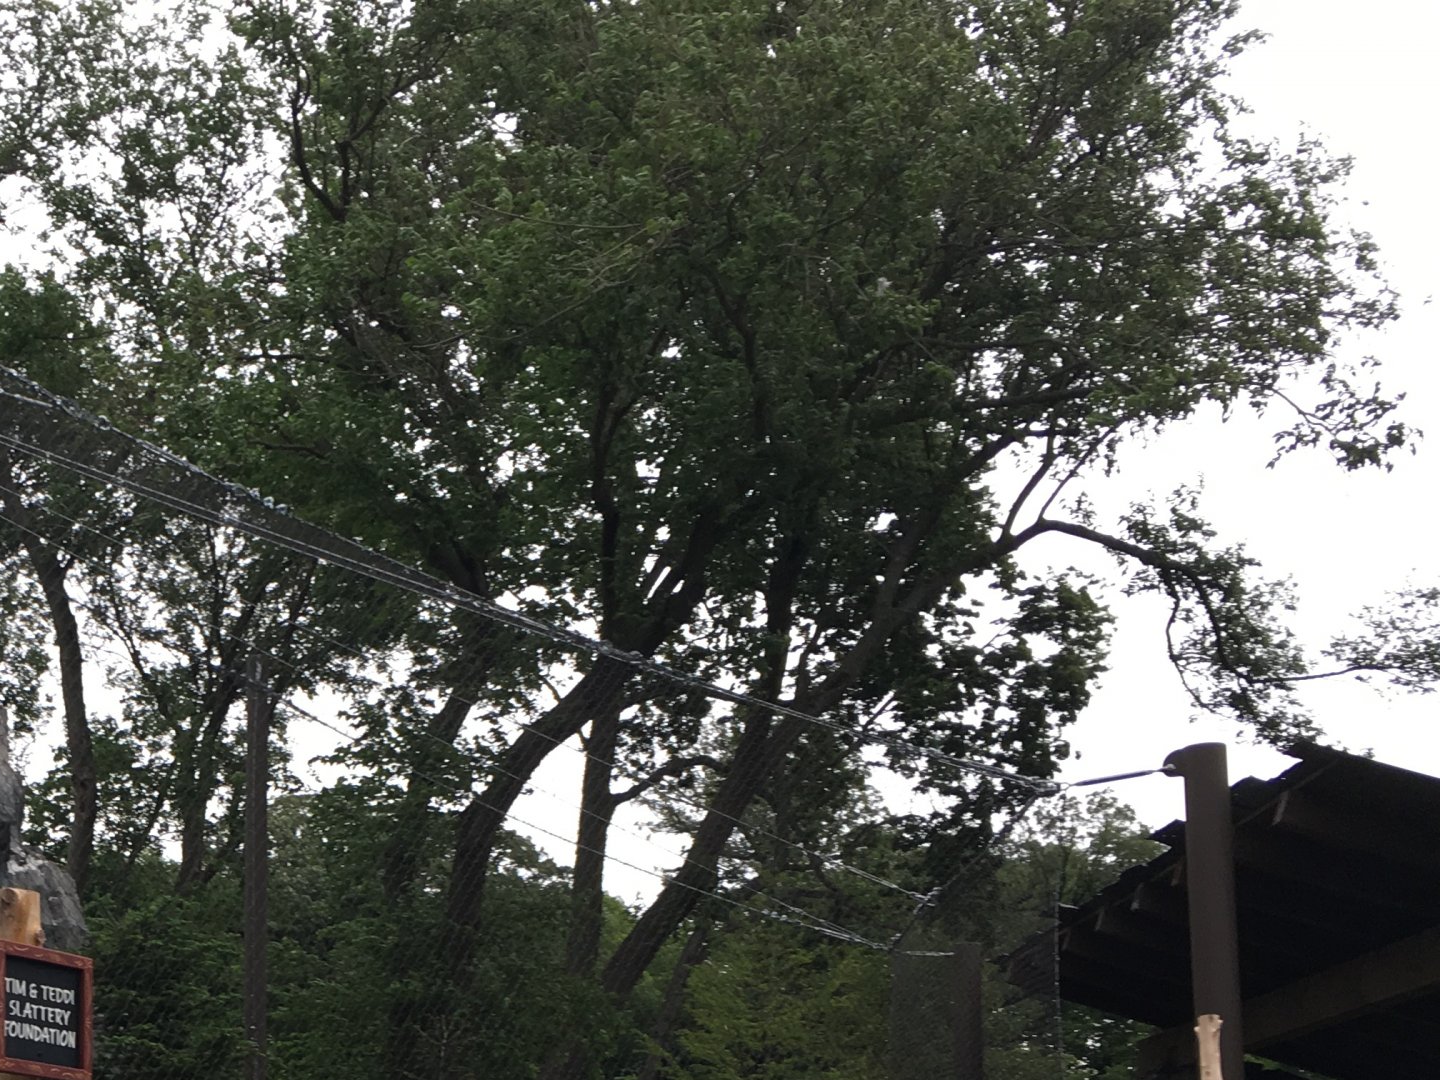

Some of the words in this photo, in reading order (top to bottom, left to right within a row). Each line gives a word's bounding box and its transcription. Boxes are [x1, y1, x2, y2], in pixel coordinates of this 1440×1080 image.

[4, 977, 27, 997] TIM
[29, 983, 39, 999] &
[40, 984, 76, 1006] TEDDI
[9, 999, 72, 1026] SLATTERY
[4, 1019, 77, 1049] FOUNDATION
